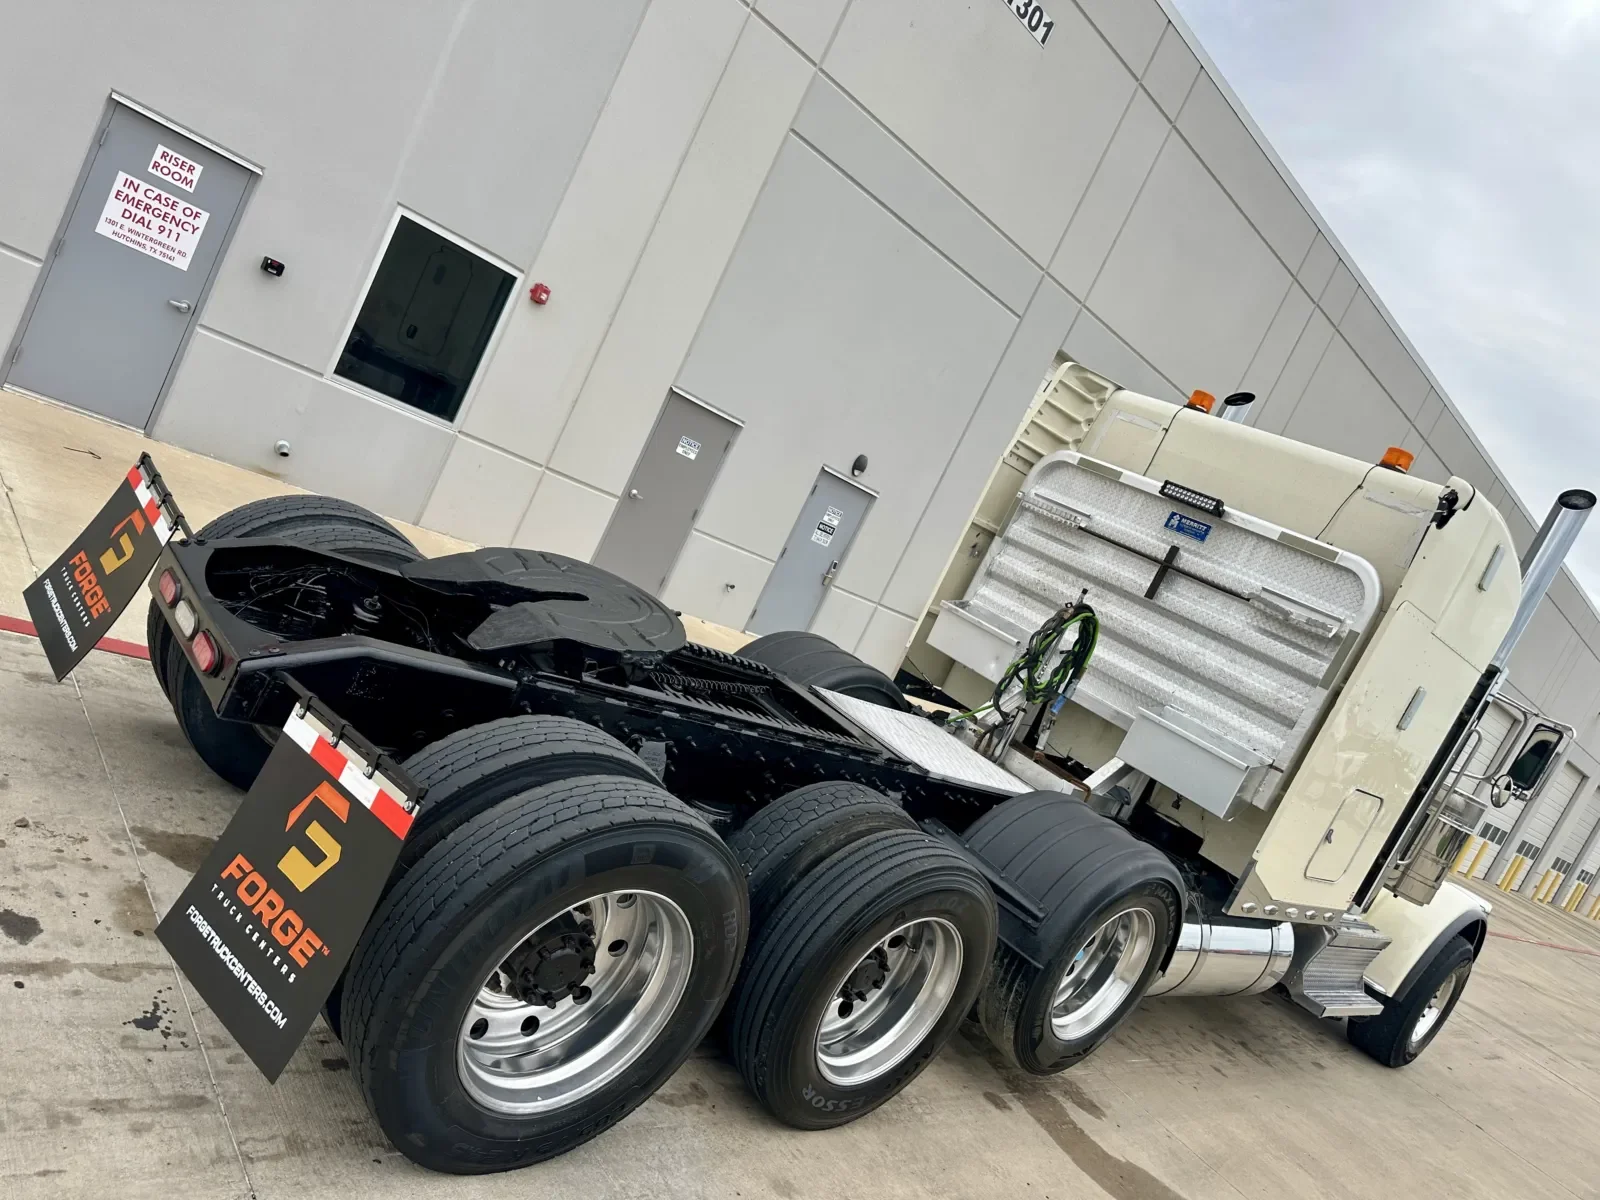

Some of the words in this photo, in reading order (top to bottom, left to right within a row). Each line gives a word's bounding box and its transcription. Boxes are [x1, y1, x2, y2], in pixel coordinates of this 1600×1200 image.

[1006, 0, 1054, 45] 301
[152, 161, 194, 188] ROOM
[160, 151, 196, 175] RISER
[114, 190, 200, 235] EMERGENCY
[122, 178, 141, 193] IN
[144, 188, 179, 211] CASE
[183, 206, 202, 221] OF
[104, 217, 119, 228] 1301
[127, 227, 175, 253] WINTERGREEN
[112, 230, 148, 251] HUTCHINS,
[149, 246, 158, 254] TX
[158, 250, 175, 262] 75141
[121, 209, 152, 230] DIAL
[158, 225, 181, 242] 911
[819, 523, 834, 534] NOTICE
[61, 567, 72, 591] TRUCK
[71, 592, 90, 628] CENTERS
[69, 550, 108, 619] FORGE
[42, 578, 78, 652] FORGETRUCKCENTERS.COM
[220, 853, 323, 968] FORGE
[210, 883, 242, 923] TRUCK
[245, 923, 297, 984] CENTERS
[186, 904, 288, 1030] FORGETRUCKCENTERS.COM
